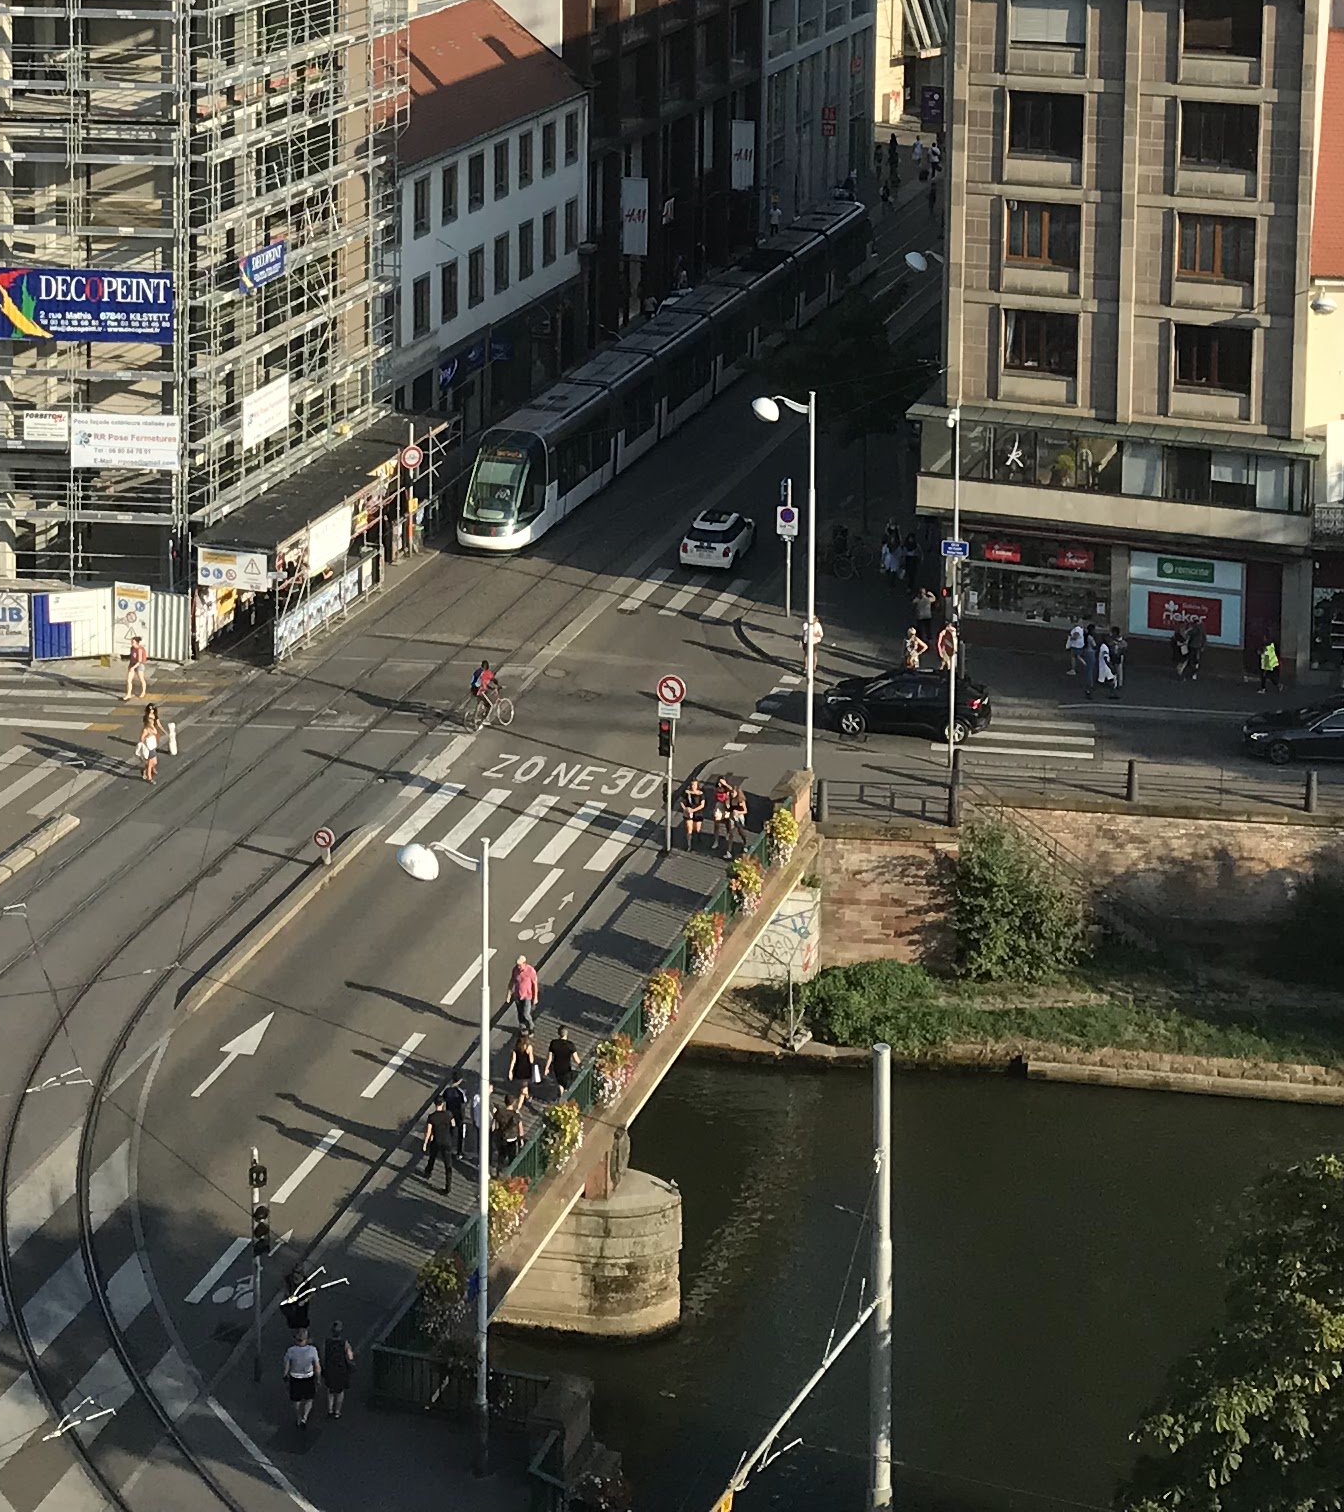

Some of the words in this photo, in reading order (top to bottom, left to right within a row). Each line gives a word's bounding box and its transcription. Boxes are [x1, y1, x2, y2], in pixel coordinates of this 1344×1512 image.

[39, 275, 170, 304] DECOPEINT
[66, 311, 92, 320] Mathis
[130, 313, 170, 321] KILSTETT
[108, 433, 129, 441] Pose
[131, 434, 177, 443] Fermetures
[482, 753, 607, 791] ZONE
[600, 766, 666, 800] 30
